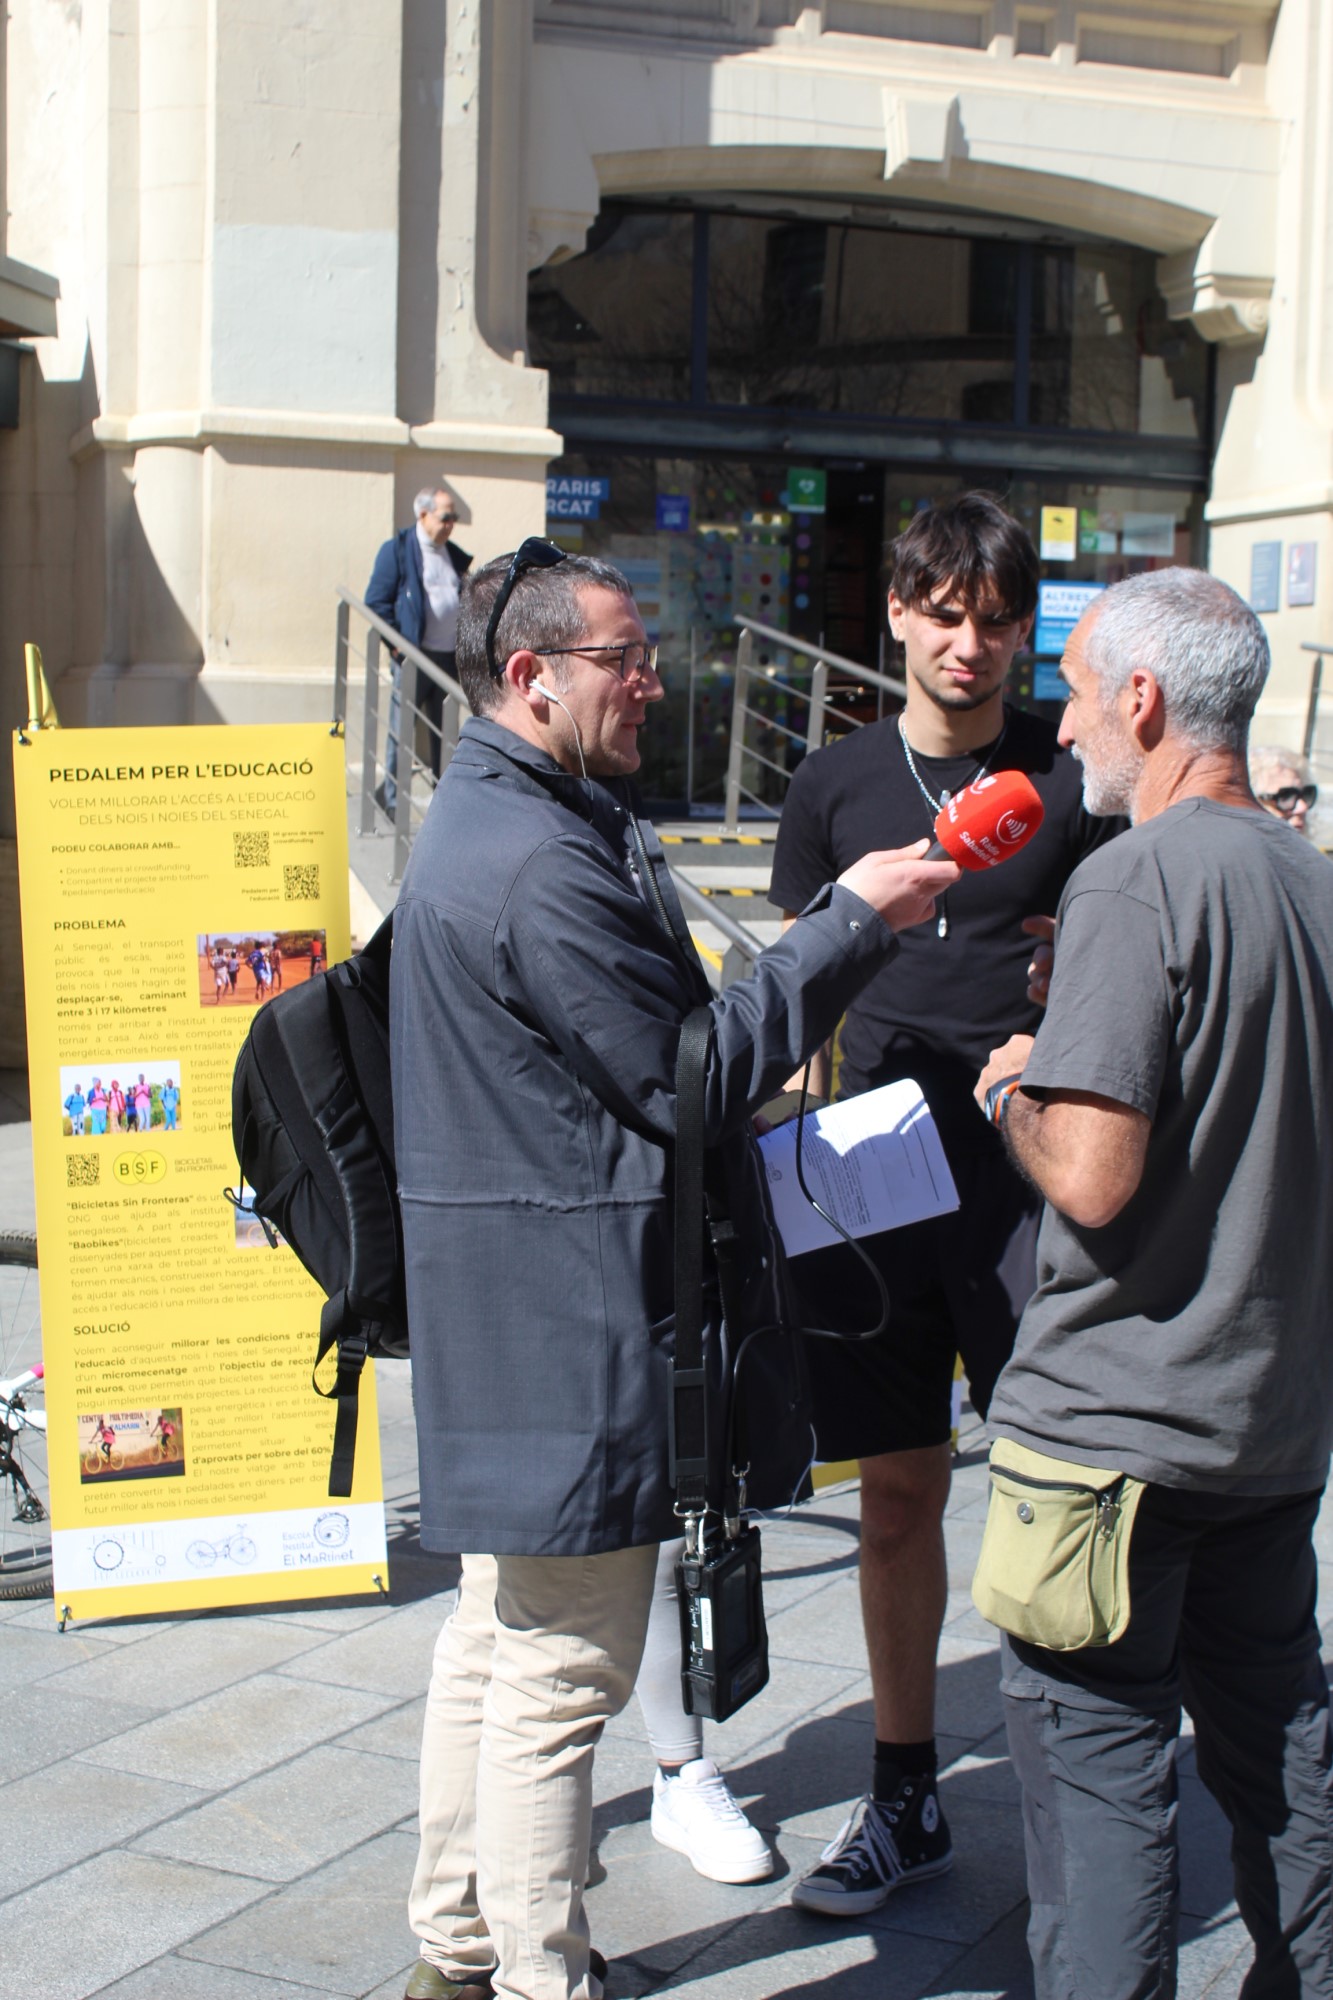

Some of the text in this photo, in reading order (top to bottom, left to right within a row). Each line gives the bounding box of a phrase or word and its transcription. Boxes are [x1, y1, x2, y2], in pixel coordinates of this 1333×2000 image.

[49, 757, 313, 782] PEDALEM PER L'EDUCACIÓ
[49, 789, 316, 809] VOLEM MILLORAR L'ACCÉS A L'EDUCACIÓ
[79, 814, 112, 826] DELS
[116, 812, 148, 824] NOIS
[158, 810, 198, 823] NOIES
[201, 809, 227, 821] DEL
[230, 808, 289, 820] SENEGAL
[51, 844, 86, 853] PODEU
[89, 842, 149, 852] COLABORAR
[66, 866, 96, 875] Donant
[98, 864, 124, 873] diners
[134, 862, 191, 872] crowdfunding
[66, 876, 112, 887] Compartint
[124, 874, 157, 885] projecte
[159, 873, 177, 882] amb
[54, 919, 126, 931] PROBLEMA
[54, 943, 64, 952] Al
[122, 940, 131, 949] el
[140, 939, 184, 949] transport
[54, 955, 85, 966] públic
[55, 965, 186, 979] provoca que la majoria
[56, 982, 76, 992] dels
[80, 981, 100, 990] nois
[112, 979, 138, 988] noies
[141, 977, 169, 988] hagin
[174, 977, 186, 986] de
[139, 990, 187, 1001] caminant
[57, 1008, 84, 1017] entre
[87, 1007, 93, 1016] 3
[101, 1006, 111, 1015] 17
[113, 1004, 167, 1015] kilòmetres
[97, 1021, 112, 1031] per
[119, 1019, 150, 1029] arribar
[221, 1015, 253, 1026] despré
[58, 1035, 88, 1045] tornar
[166, 1031, 179, 1039] els
[186, 1029, 232, 1039] comporta
[115, 1046, 149, 1055] moltes
[151, 1044, 178, 1054] hores
[180, 1044, 192, 1052] en
[192, 1098, 225, 1107] escolar
[193, 1110, 208, 1119] fan
[123, 1197, 138, 1207] Sin
[67, 1206, 229, 1224] ONG que ajuda als instituts
[137, 1223, 144, 1232] A
[152, 1221, 172, 1232] part
[181, 1233, 218, 1243] creades
[73, 1320, 131, 1336] SOLUCIÓ
[74, 1333, 290, 1356] Volem aconseguir millorar les condicions
[181, 1351, 200, 1361] nois
[213, 1348, 238, 1358] noies
[243, 1346, 258, 1356] del
[102, 1366, 188, 1380] micromecenatge
[193, 1362, 215, 1373] amb
[271, 1358, 283, 1367] de
[76, 1385, 92, 1395] mil
[128, 1381, 147, 1391] que
[197, 1377, 216, 1387] que
[219, 1374, 264, 1384] bicicletes
[270, 1371, 297, 1380] sense
[246, 1452, 261, 1462] per
[264, 1449, 291, 1459] sobre
[294, 1447, 309, 1456] del
[84, 1505, 108, 1515] futur
[111, 1503, 138, 1513] millor
[141, 1501, 154, 1510] als
[157, 1499, 176, 1508] nois
[183, 1497, 209, 1506] noies
[211, 1494, 225, 1503] del
